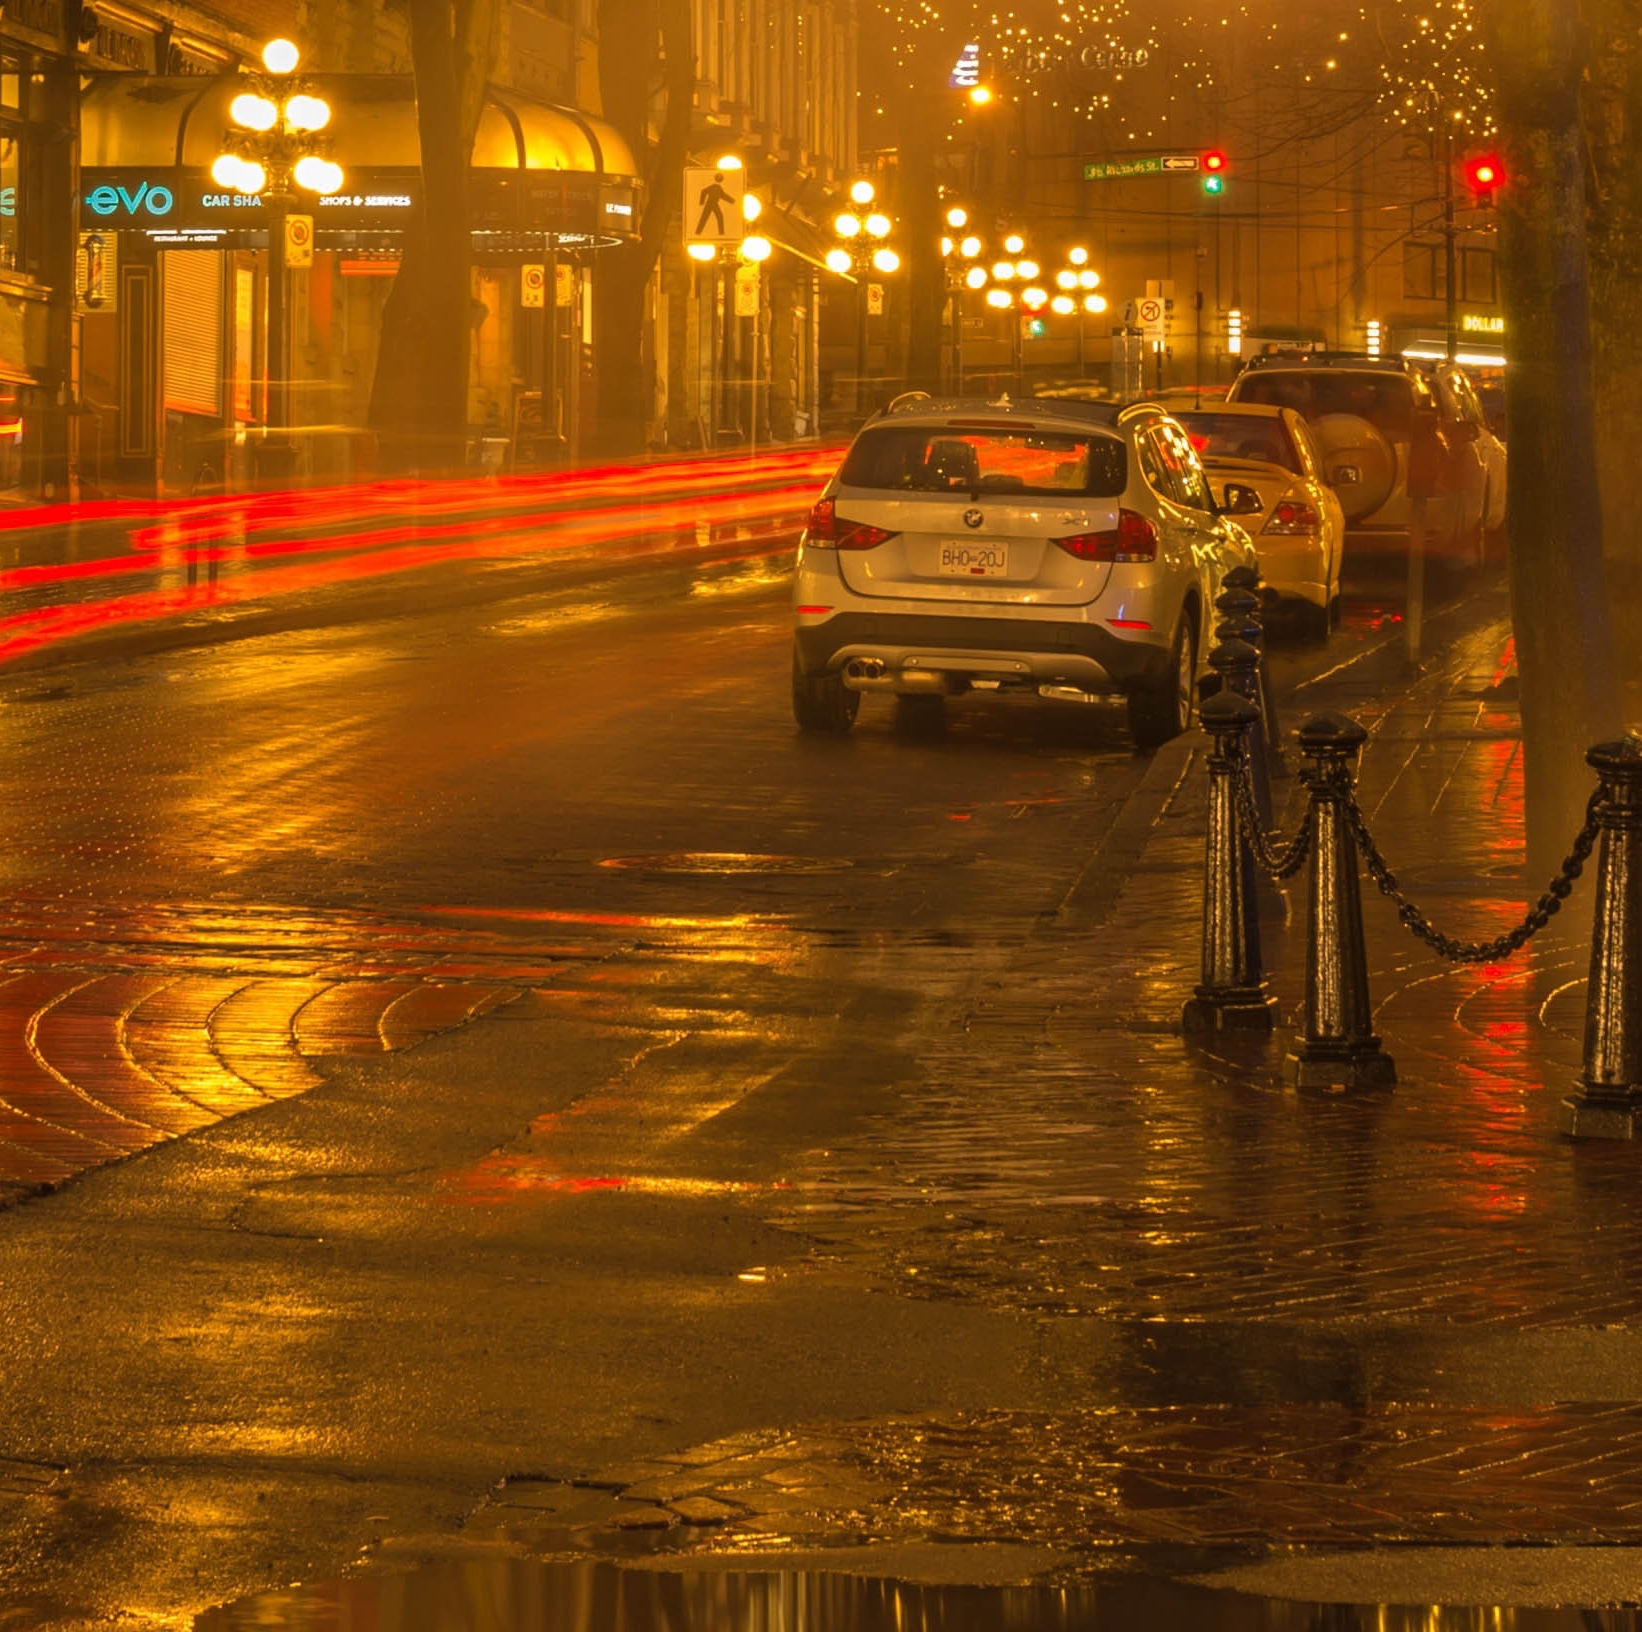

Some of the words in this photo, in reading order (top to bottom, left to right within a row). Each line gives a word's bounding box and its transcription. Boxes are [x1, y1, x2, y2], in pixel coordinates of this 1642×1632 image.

[85, 180, 173, 216] evo
[202, 195, 230, 207] CAR
[233, 195, 261, 207] SHA
